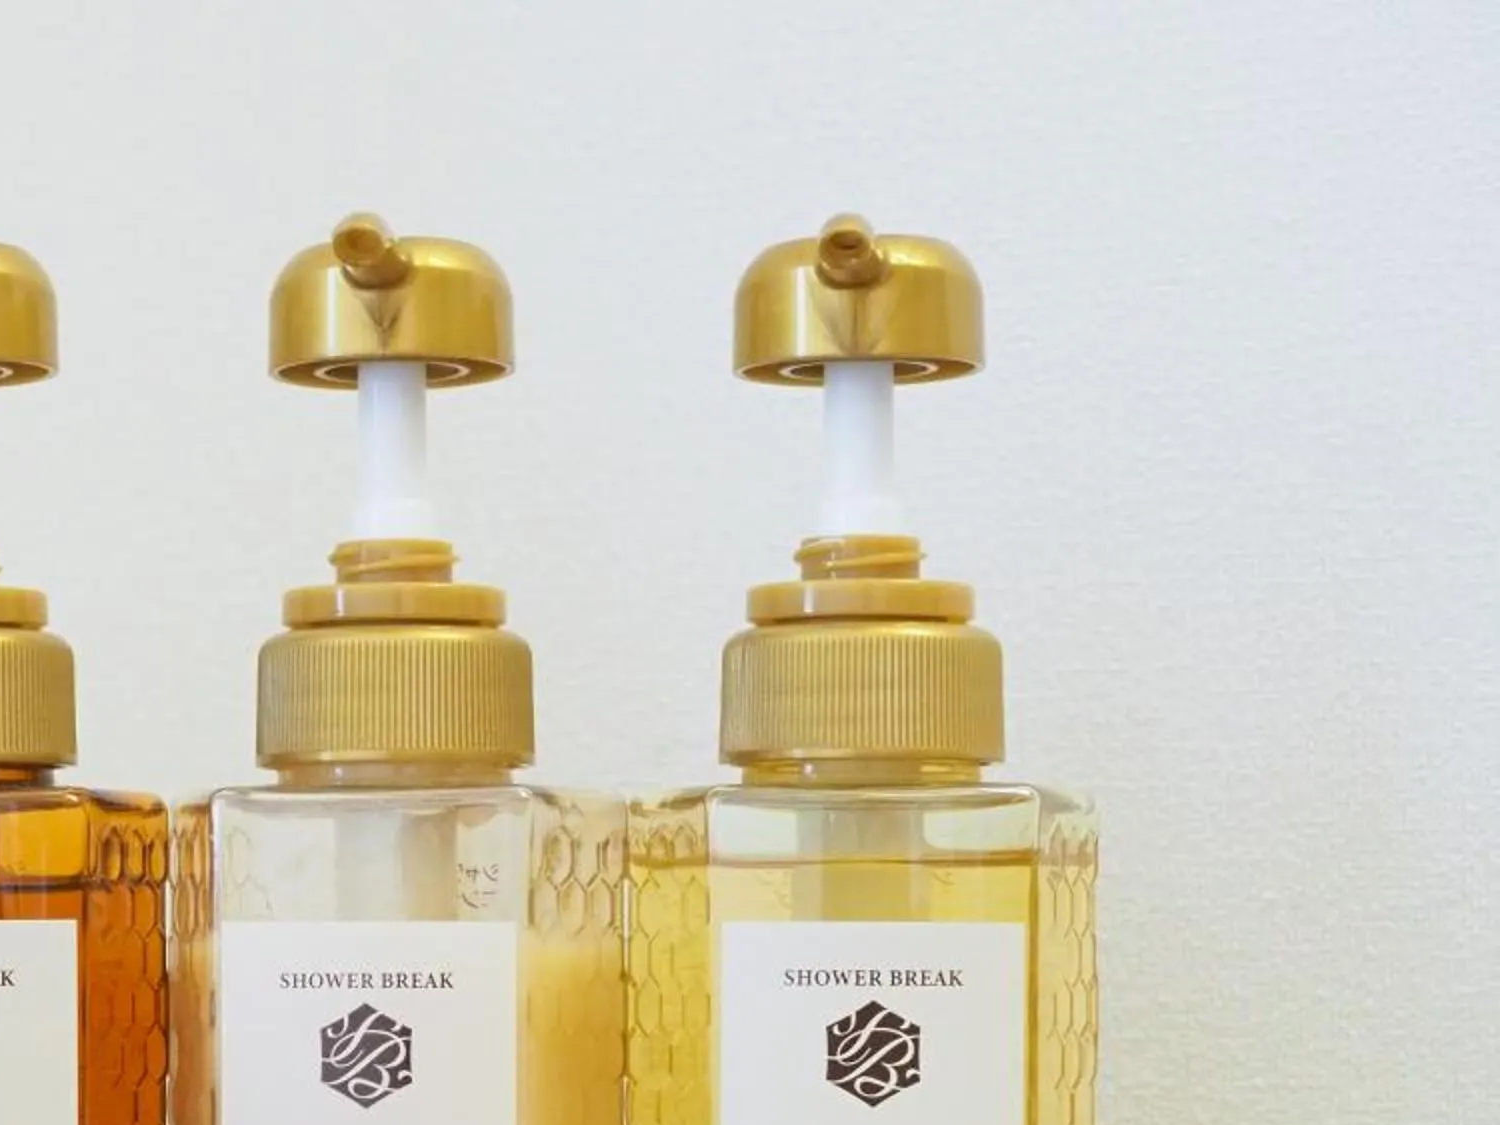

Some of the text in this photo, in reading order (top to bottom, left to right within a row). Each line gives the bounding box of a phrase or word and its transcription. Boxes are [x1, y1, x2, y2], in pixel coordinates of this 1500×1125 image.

[279, 972, 454, 990] SHOWER BREAK
[783, 969, 964, 988] SHOWER BREAK
